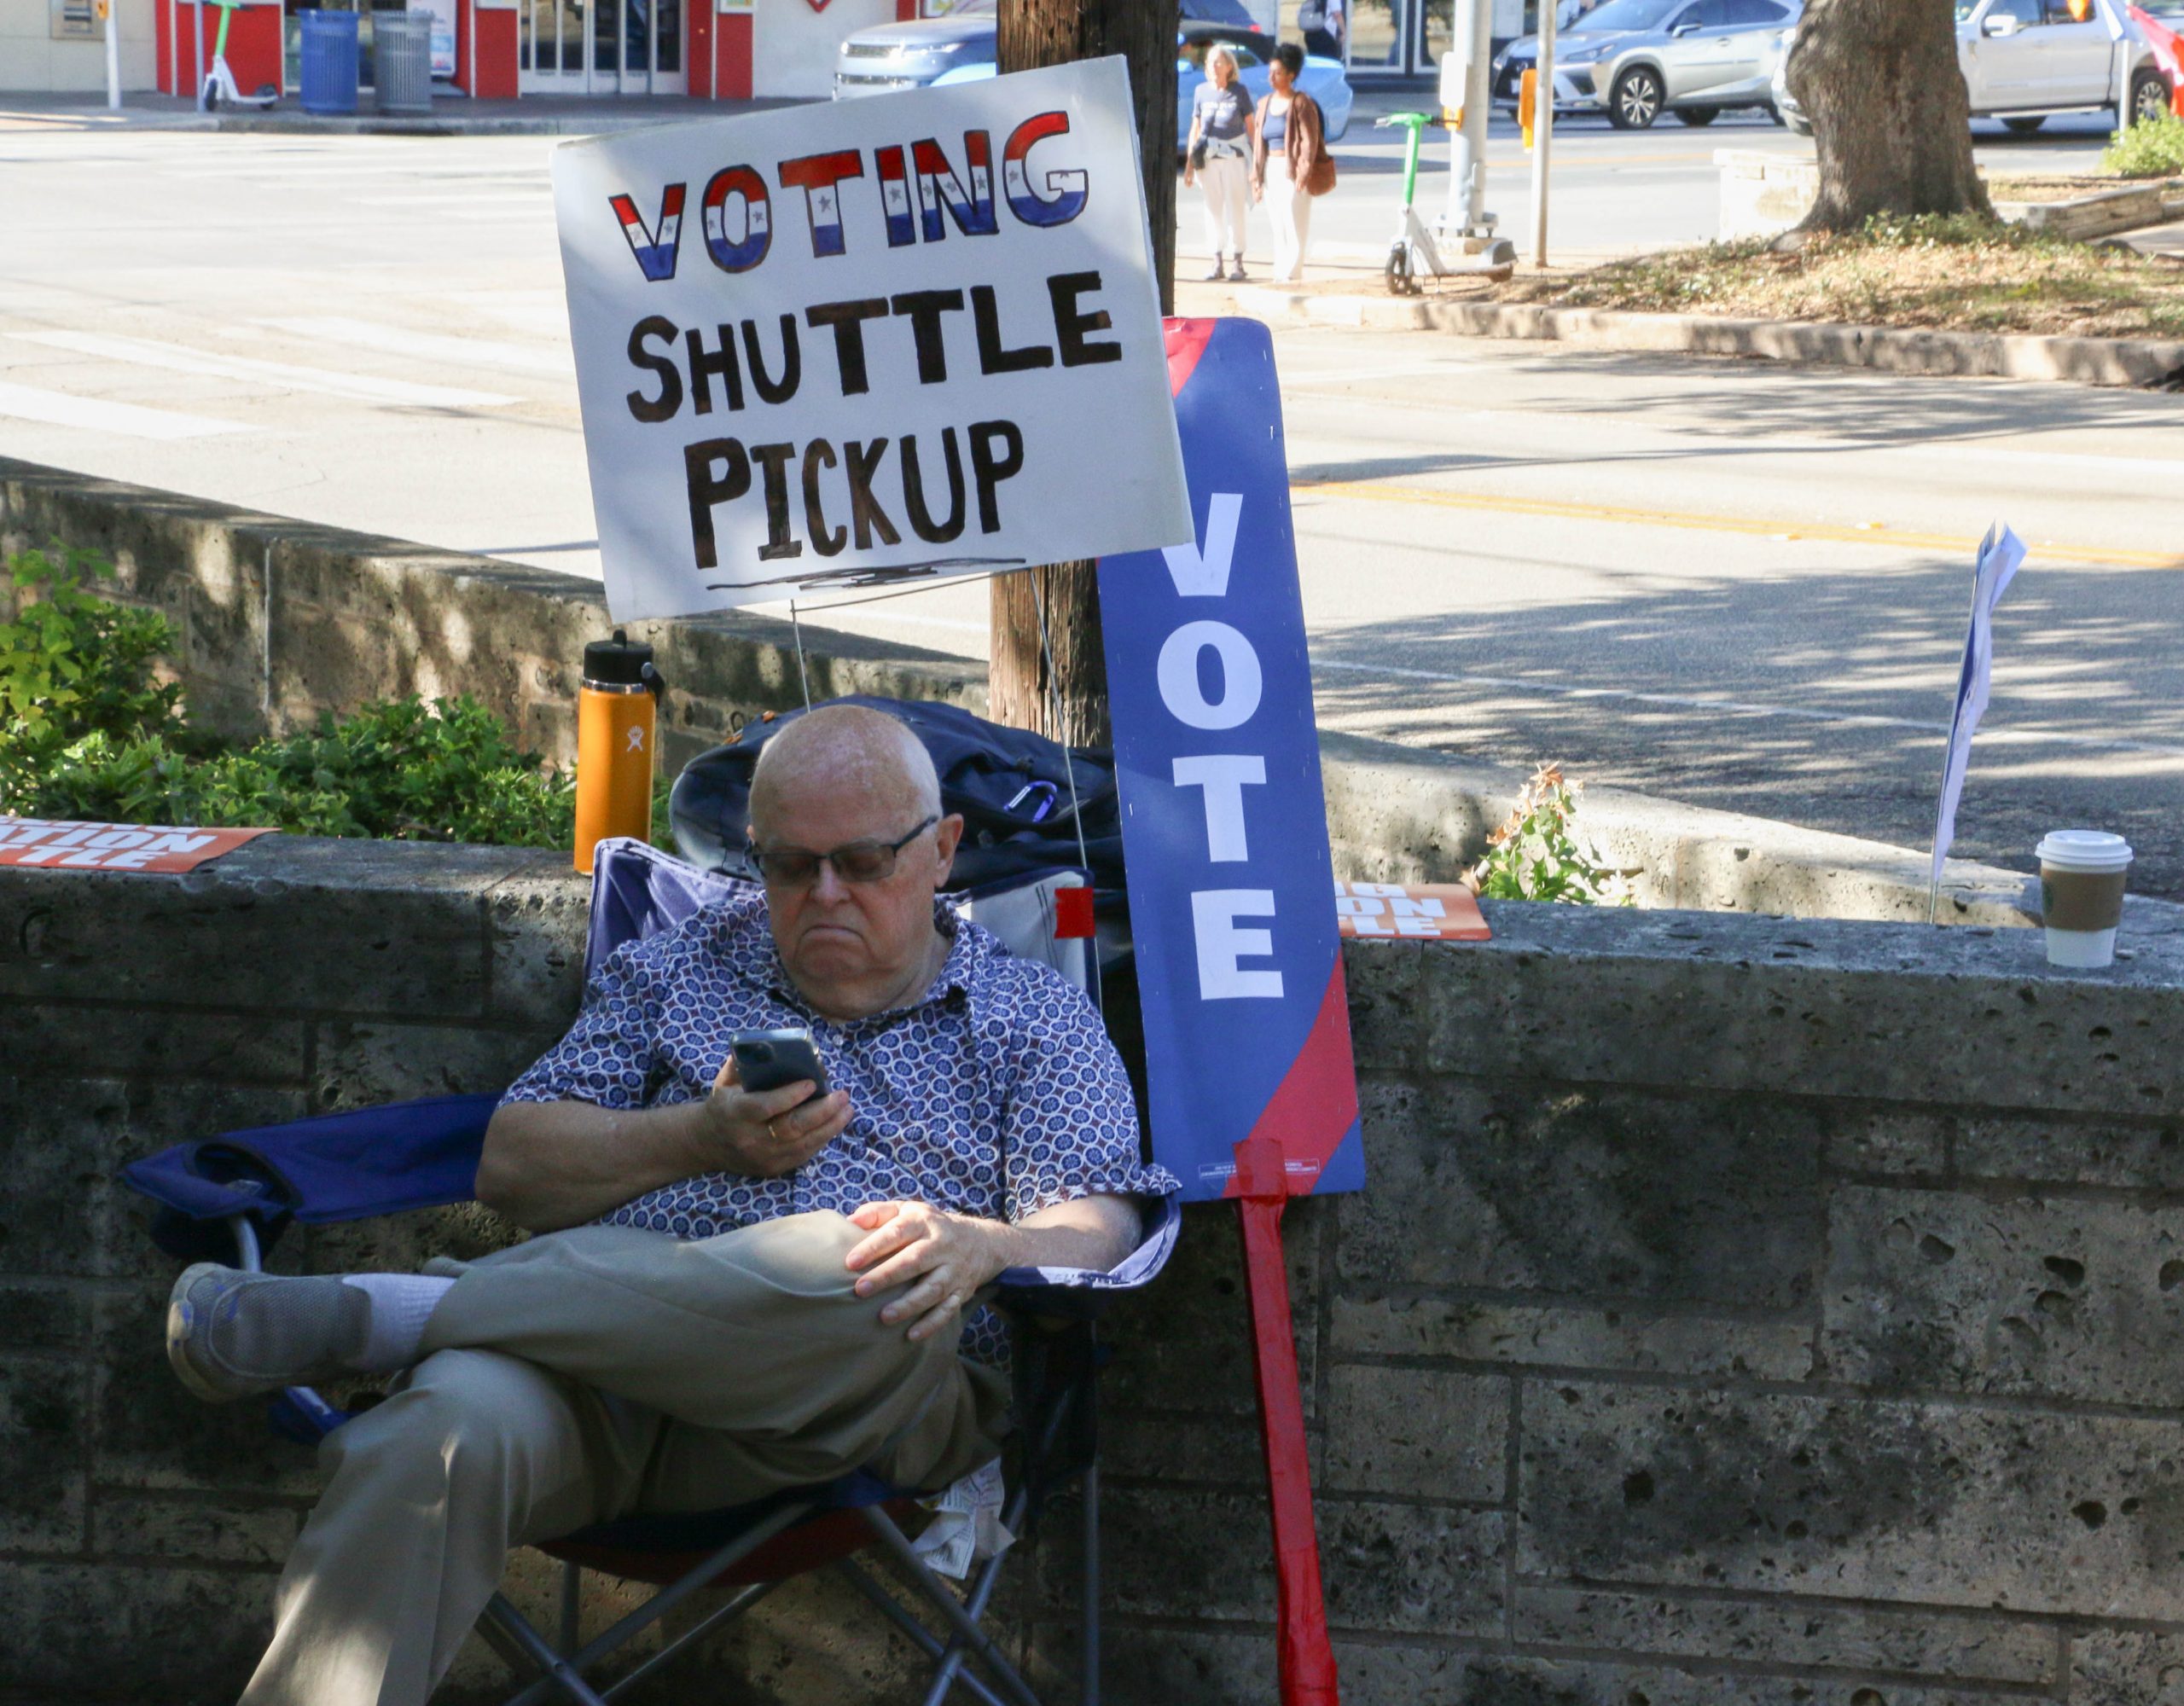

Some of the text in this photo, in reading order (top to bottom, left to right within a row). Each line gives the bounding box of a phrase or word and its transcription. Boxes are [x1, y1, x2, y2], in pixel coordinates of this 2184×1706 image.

[609, 111, 1089, 282] VOTING
[627, 270, 1122, 423] SHUTTLE
[684, 420, 1024, 570] PICKUP
[1157, 492, 1285, 1001] VOTE
